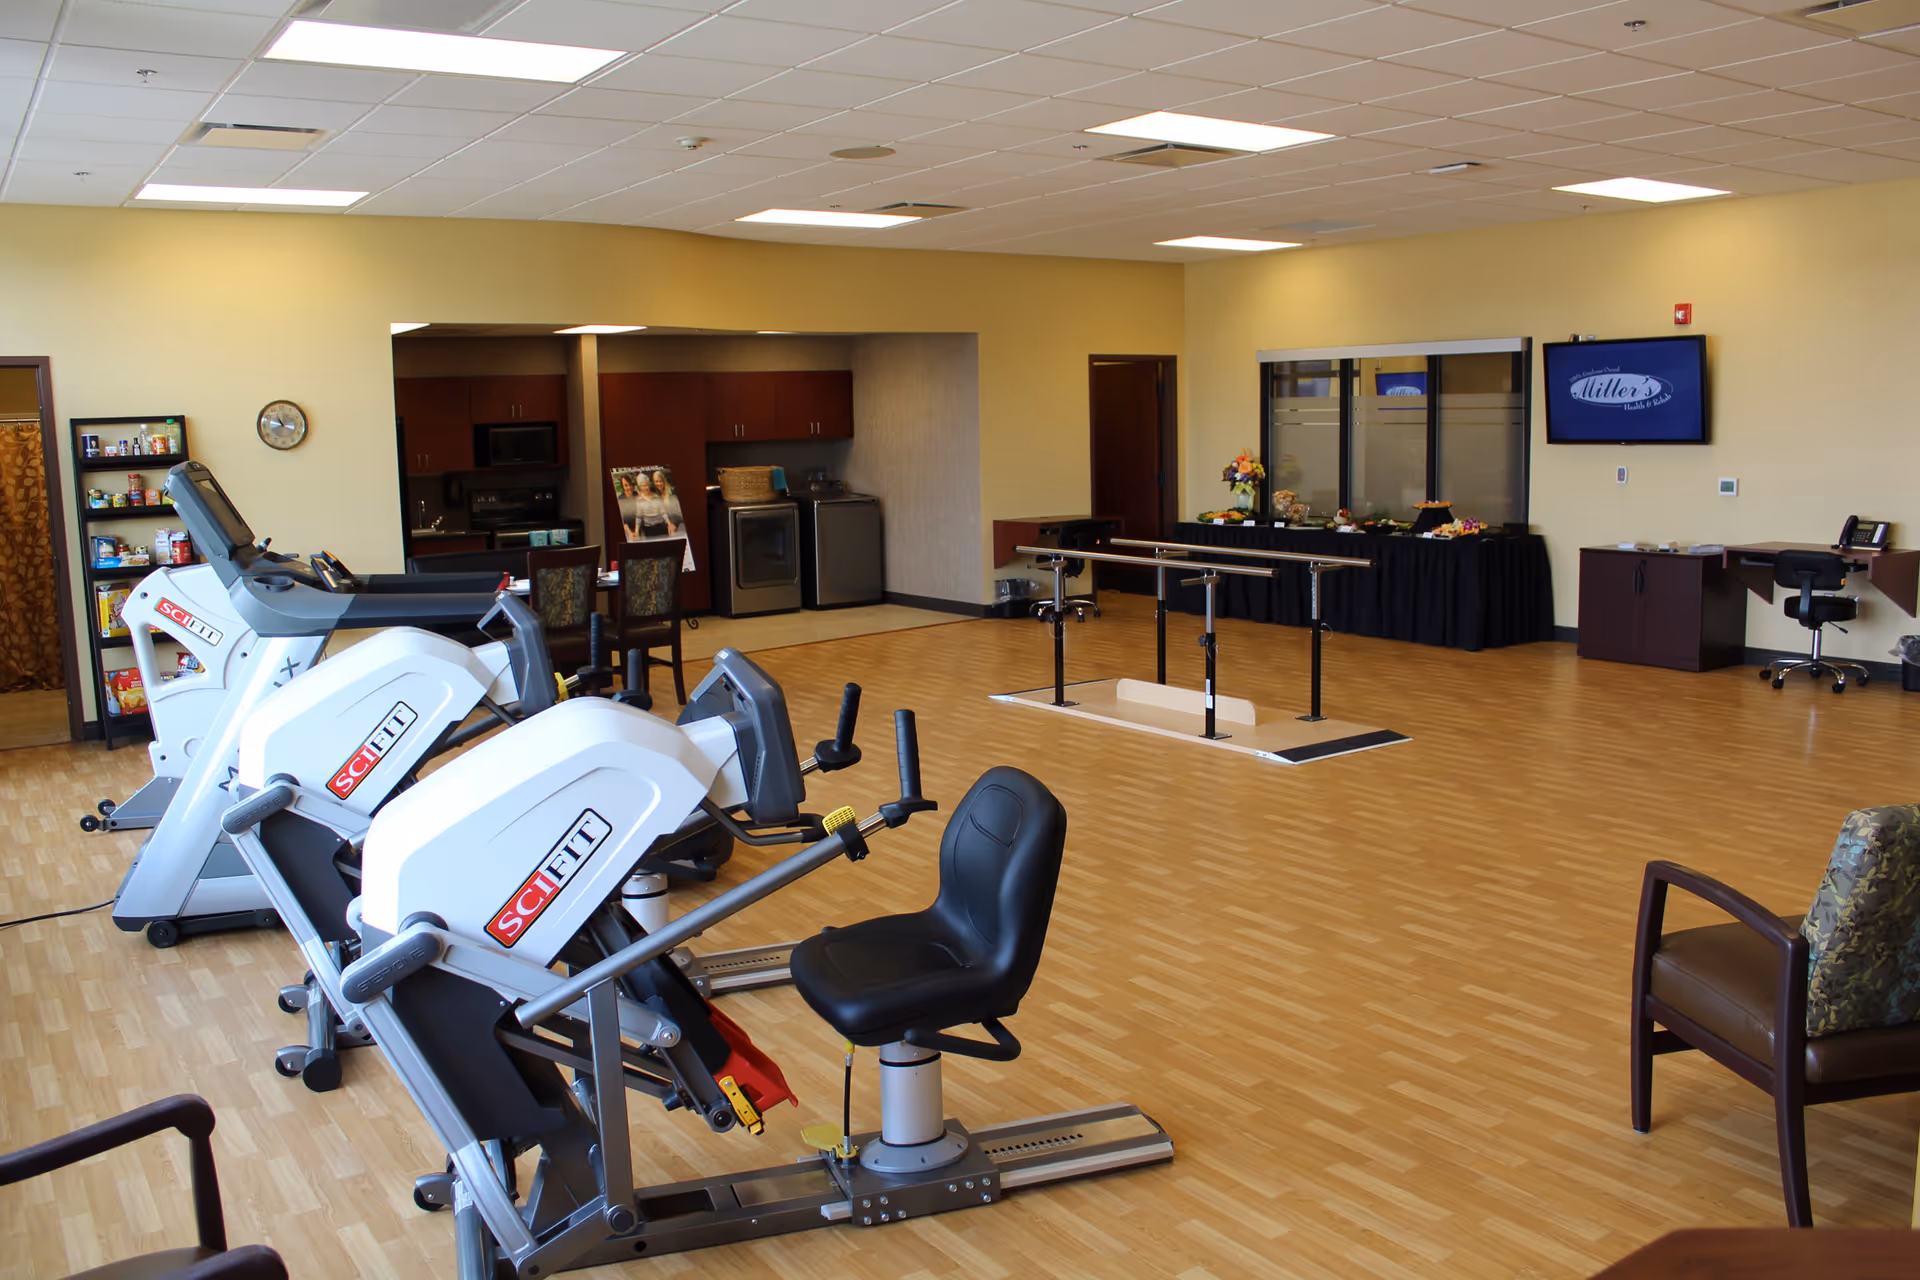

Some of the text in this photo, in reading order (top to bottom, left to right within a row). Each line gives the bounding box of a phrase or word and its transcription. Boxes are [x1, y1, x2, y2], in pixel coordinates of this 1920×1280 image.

[1573, 375, 1653, 399] Miller's
[1624, 402, 1645, 411] Health
[160, 602, 219, 639] SCIFIT
[335, 708, 407, 793] SCIFIT
[497, 819, 596, 938] SCIFIT
